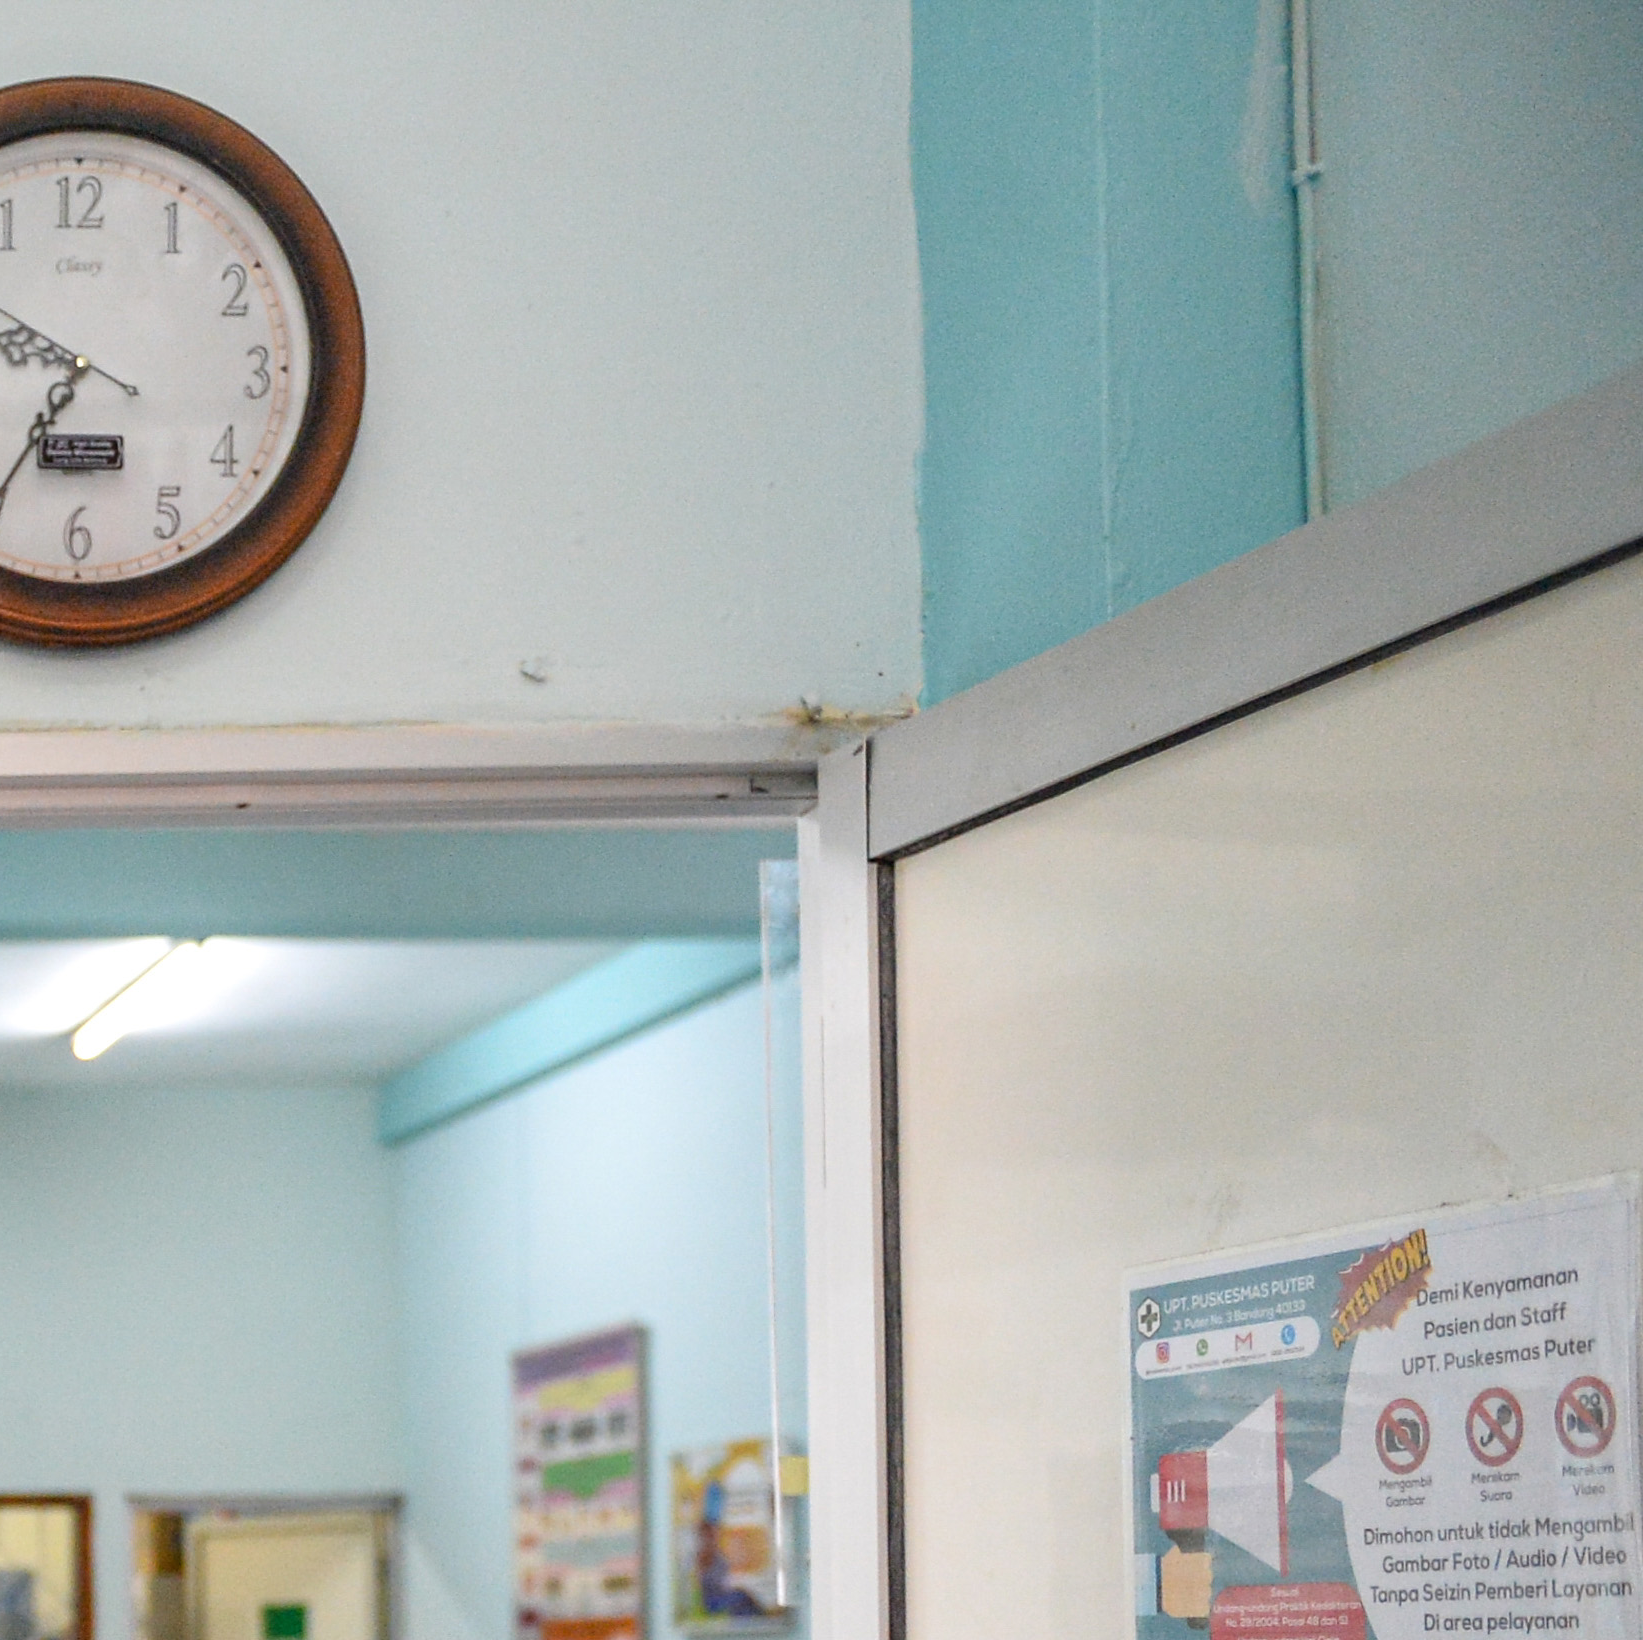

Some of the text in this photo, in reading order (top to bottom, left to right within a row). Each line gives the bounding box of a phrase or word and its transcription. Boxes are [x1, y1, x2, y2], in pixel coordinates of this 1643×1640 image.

[55, 176, 104, 229] 12
[164, 203, 179, 254] 1
[221, 263, 248, 317] 2
[246, 346, 271, 399] 3
[211, 425, 239, 478] 4
[154, 486, 181, 540] 5
[63, 506, 92, 561] 6
[1191, 1283, 1269, 1309] PUSKESMAS
[1271, 1275, 1315, 1295] PUTER
[1331, 1228, 1430, 1349] ATTENTION!
[1417, 1268, 1579, 1307] Demi Kenyamanan
[1424, 1302, 1566, 1340] Pasien dan Staff
[1402, 1337, 1595, 1376] UPT. Puskesmas Puter
[1386, 1495, 1426, 1508] Gambar
[1480, 1490, 1513, 1503] Suara
[1573, 1483, 1605, 1496] Video
[1364, 1513, 1635, 1546] Dimohon untuk tidak Mengambil
[1382, 1546, 1627, 1574] Gambar Foto / Audio / Video
[1370, 1579, 1632, 1607] Tanpa Seizin Pemberi Layanan
[1424, 1612, 1579, 1635] Di area pelayanan
